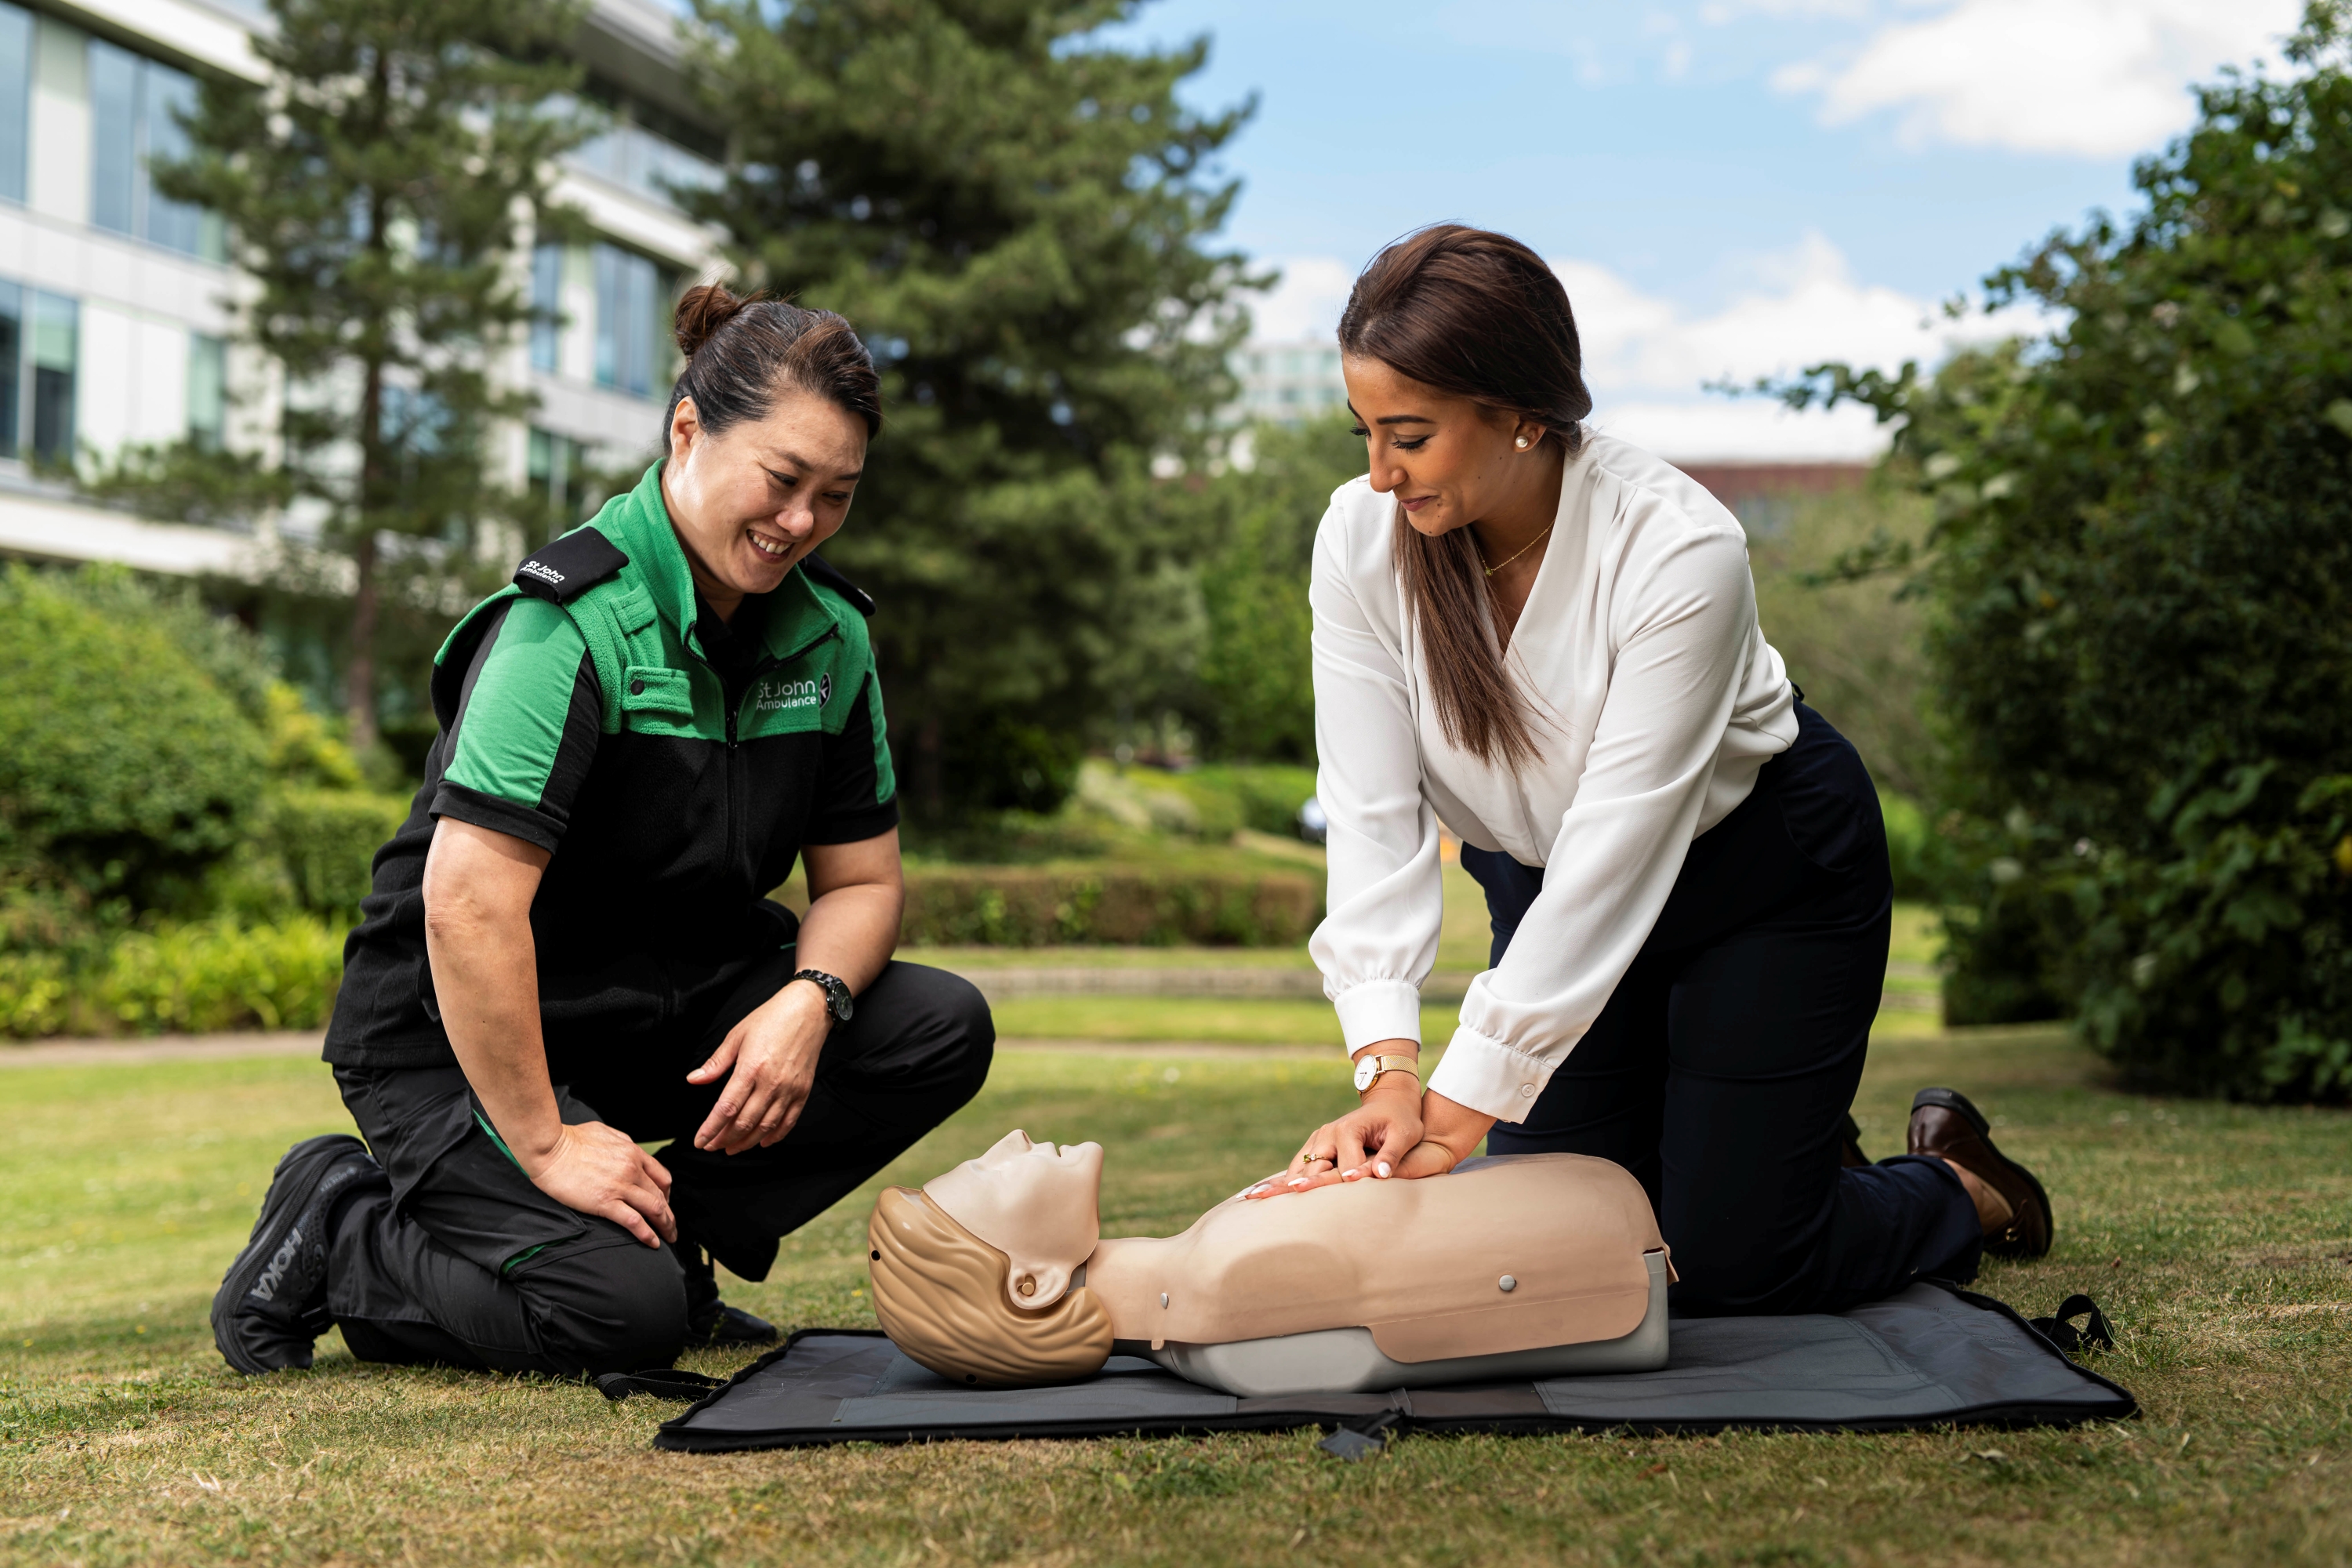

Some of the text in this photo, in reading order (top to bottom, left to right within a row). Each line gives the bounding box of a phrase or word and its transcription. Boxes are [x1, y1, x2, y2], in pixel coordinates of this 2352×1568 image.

[520, 566, 559, 583] Ambulance
[525, 561, 565, 582] St John
[774, 680, 815, 697] John
[756, 695, 817, 710] Ambulance
[250, 1227, 303, 1301] HOKA
